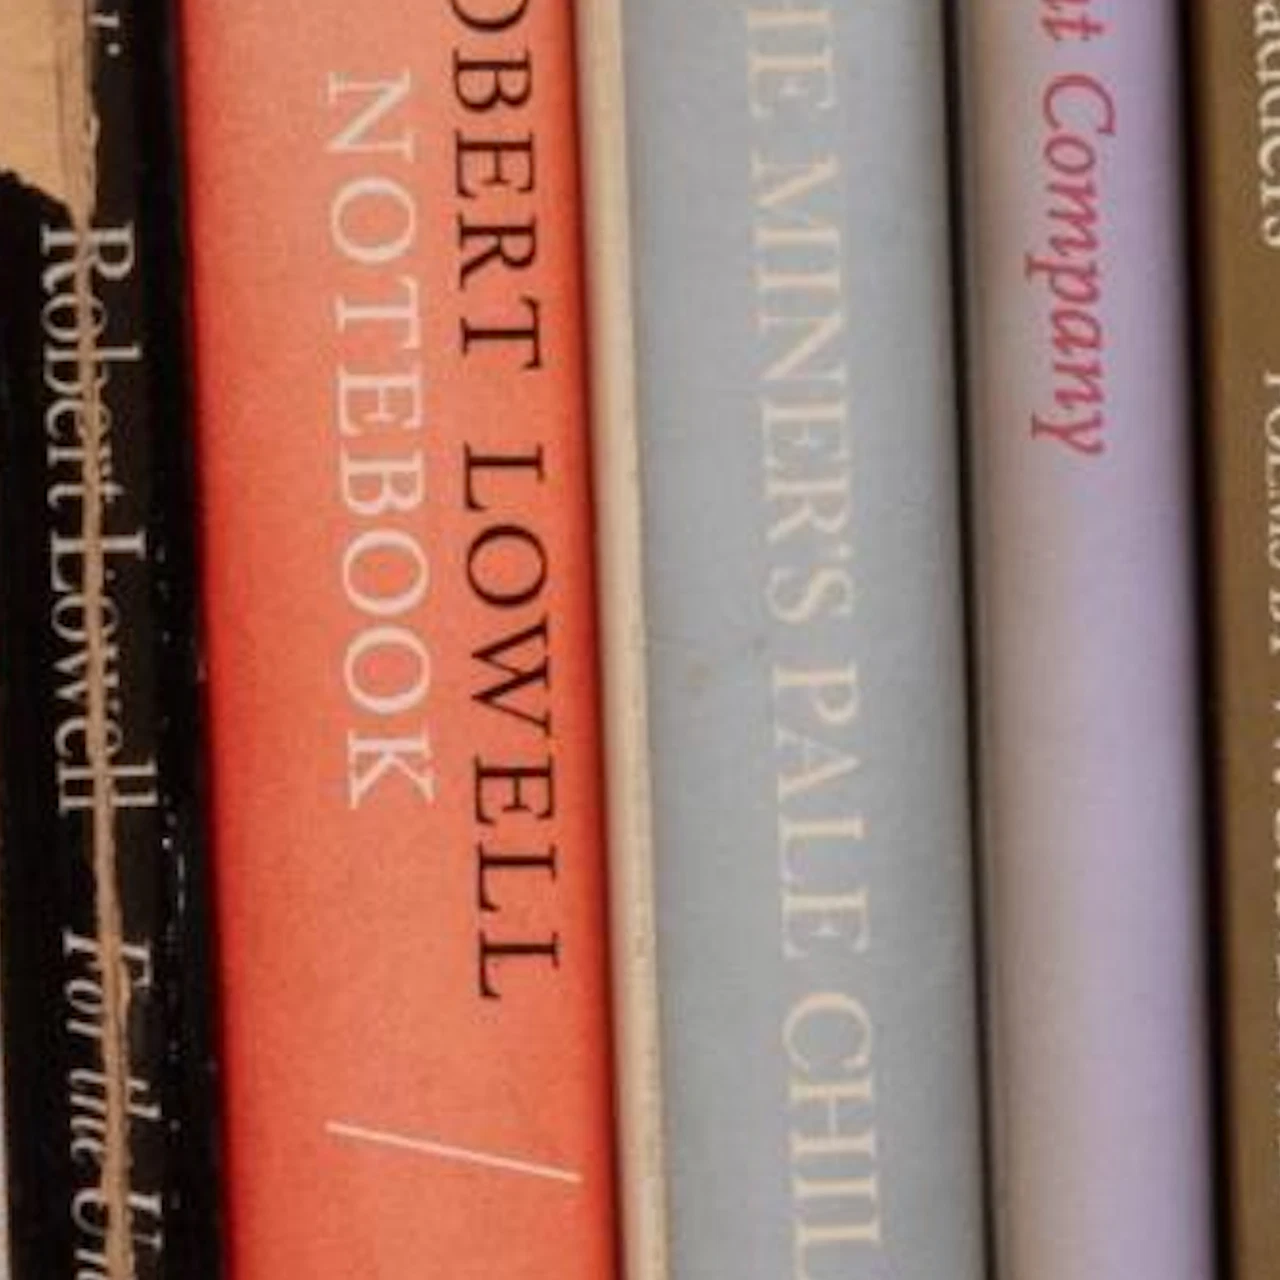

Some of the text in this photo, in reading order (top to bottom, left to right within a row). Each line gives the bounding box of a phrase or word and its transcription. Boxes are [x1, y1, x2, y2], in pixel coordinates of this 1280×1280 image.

[38, 222, 159, 816] Robert Lowell
[326, 68, 435, 811] NOTEBOOK
[750, 152, 856, 624] MINER'S
[1025, 74, 1117, 460] Company
[464, 441, 561, 1001] LOWELL
[771, 662, 872, 960] PALE
